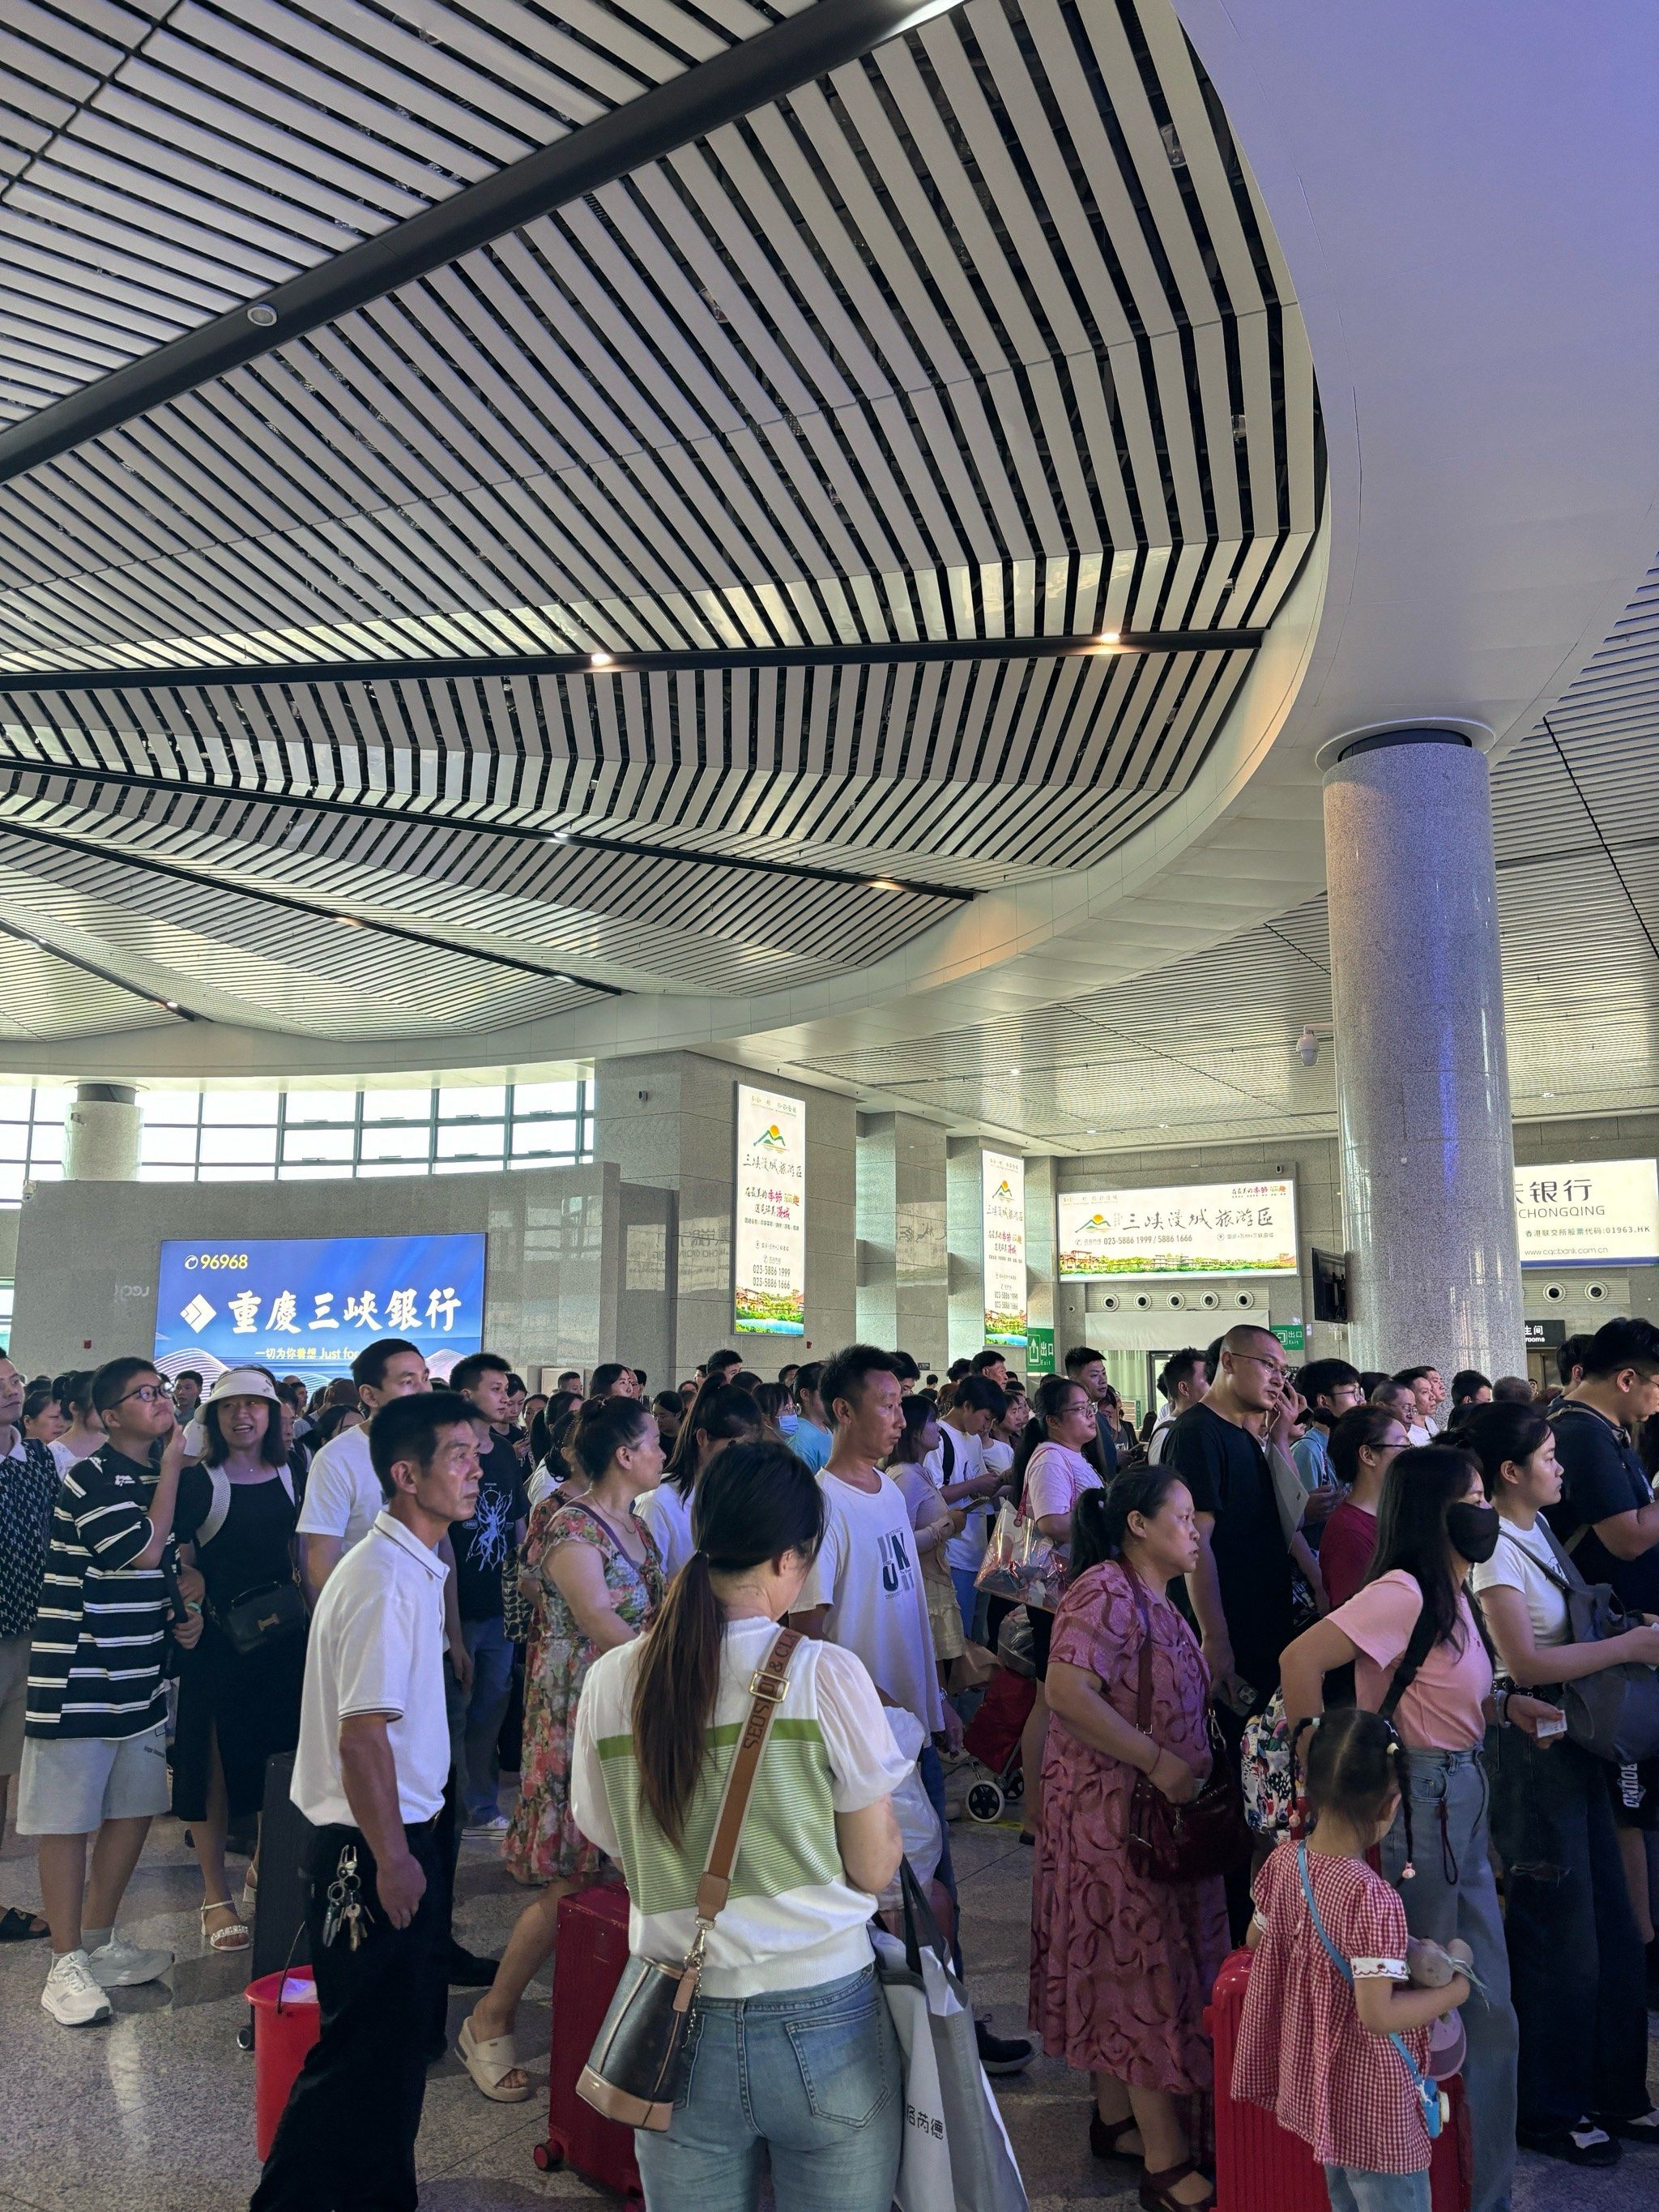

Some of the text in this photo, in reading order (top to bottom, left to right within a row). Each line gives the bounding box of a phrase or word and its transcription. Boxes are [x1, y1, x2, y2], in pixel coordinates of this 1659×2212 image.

[1518, 1205, 1606, 1219] CHONGQING
[1103, 1237, 1134, 1245] 023-5886
[1136, 1236, 1152, 1245] 1999
[1158, 1235, 1175, 1243] 5886
[1176, 1234, 1192, 1243] 1666
[200, 1253, 249, 1270] 96968
[1289, 1330, 1303, 1339] 出口
[254, 1347, 317, 1360] 一切为你着想
[321, 1347, 341, 1360] Just
[1040, 1341, 1054, 1356] 出口
